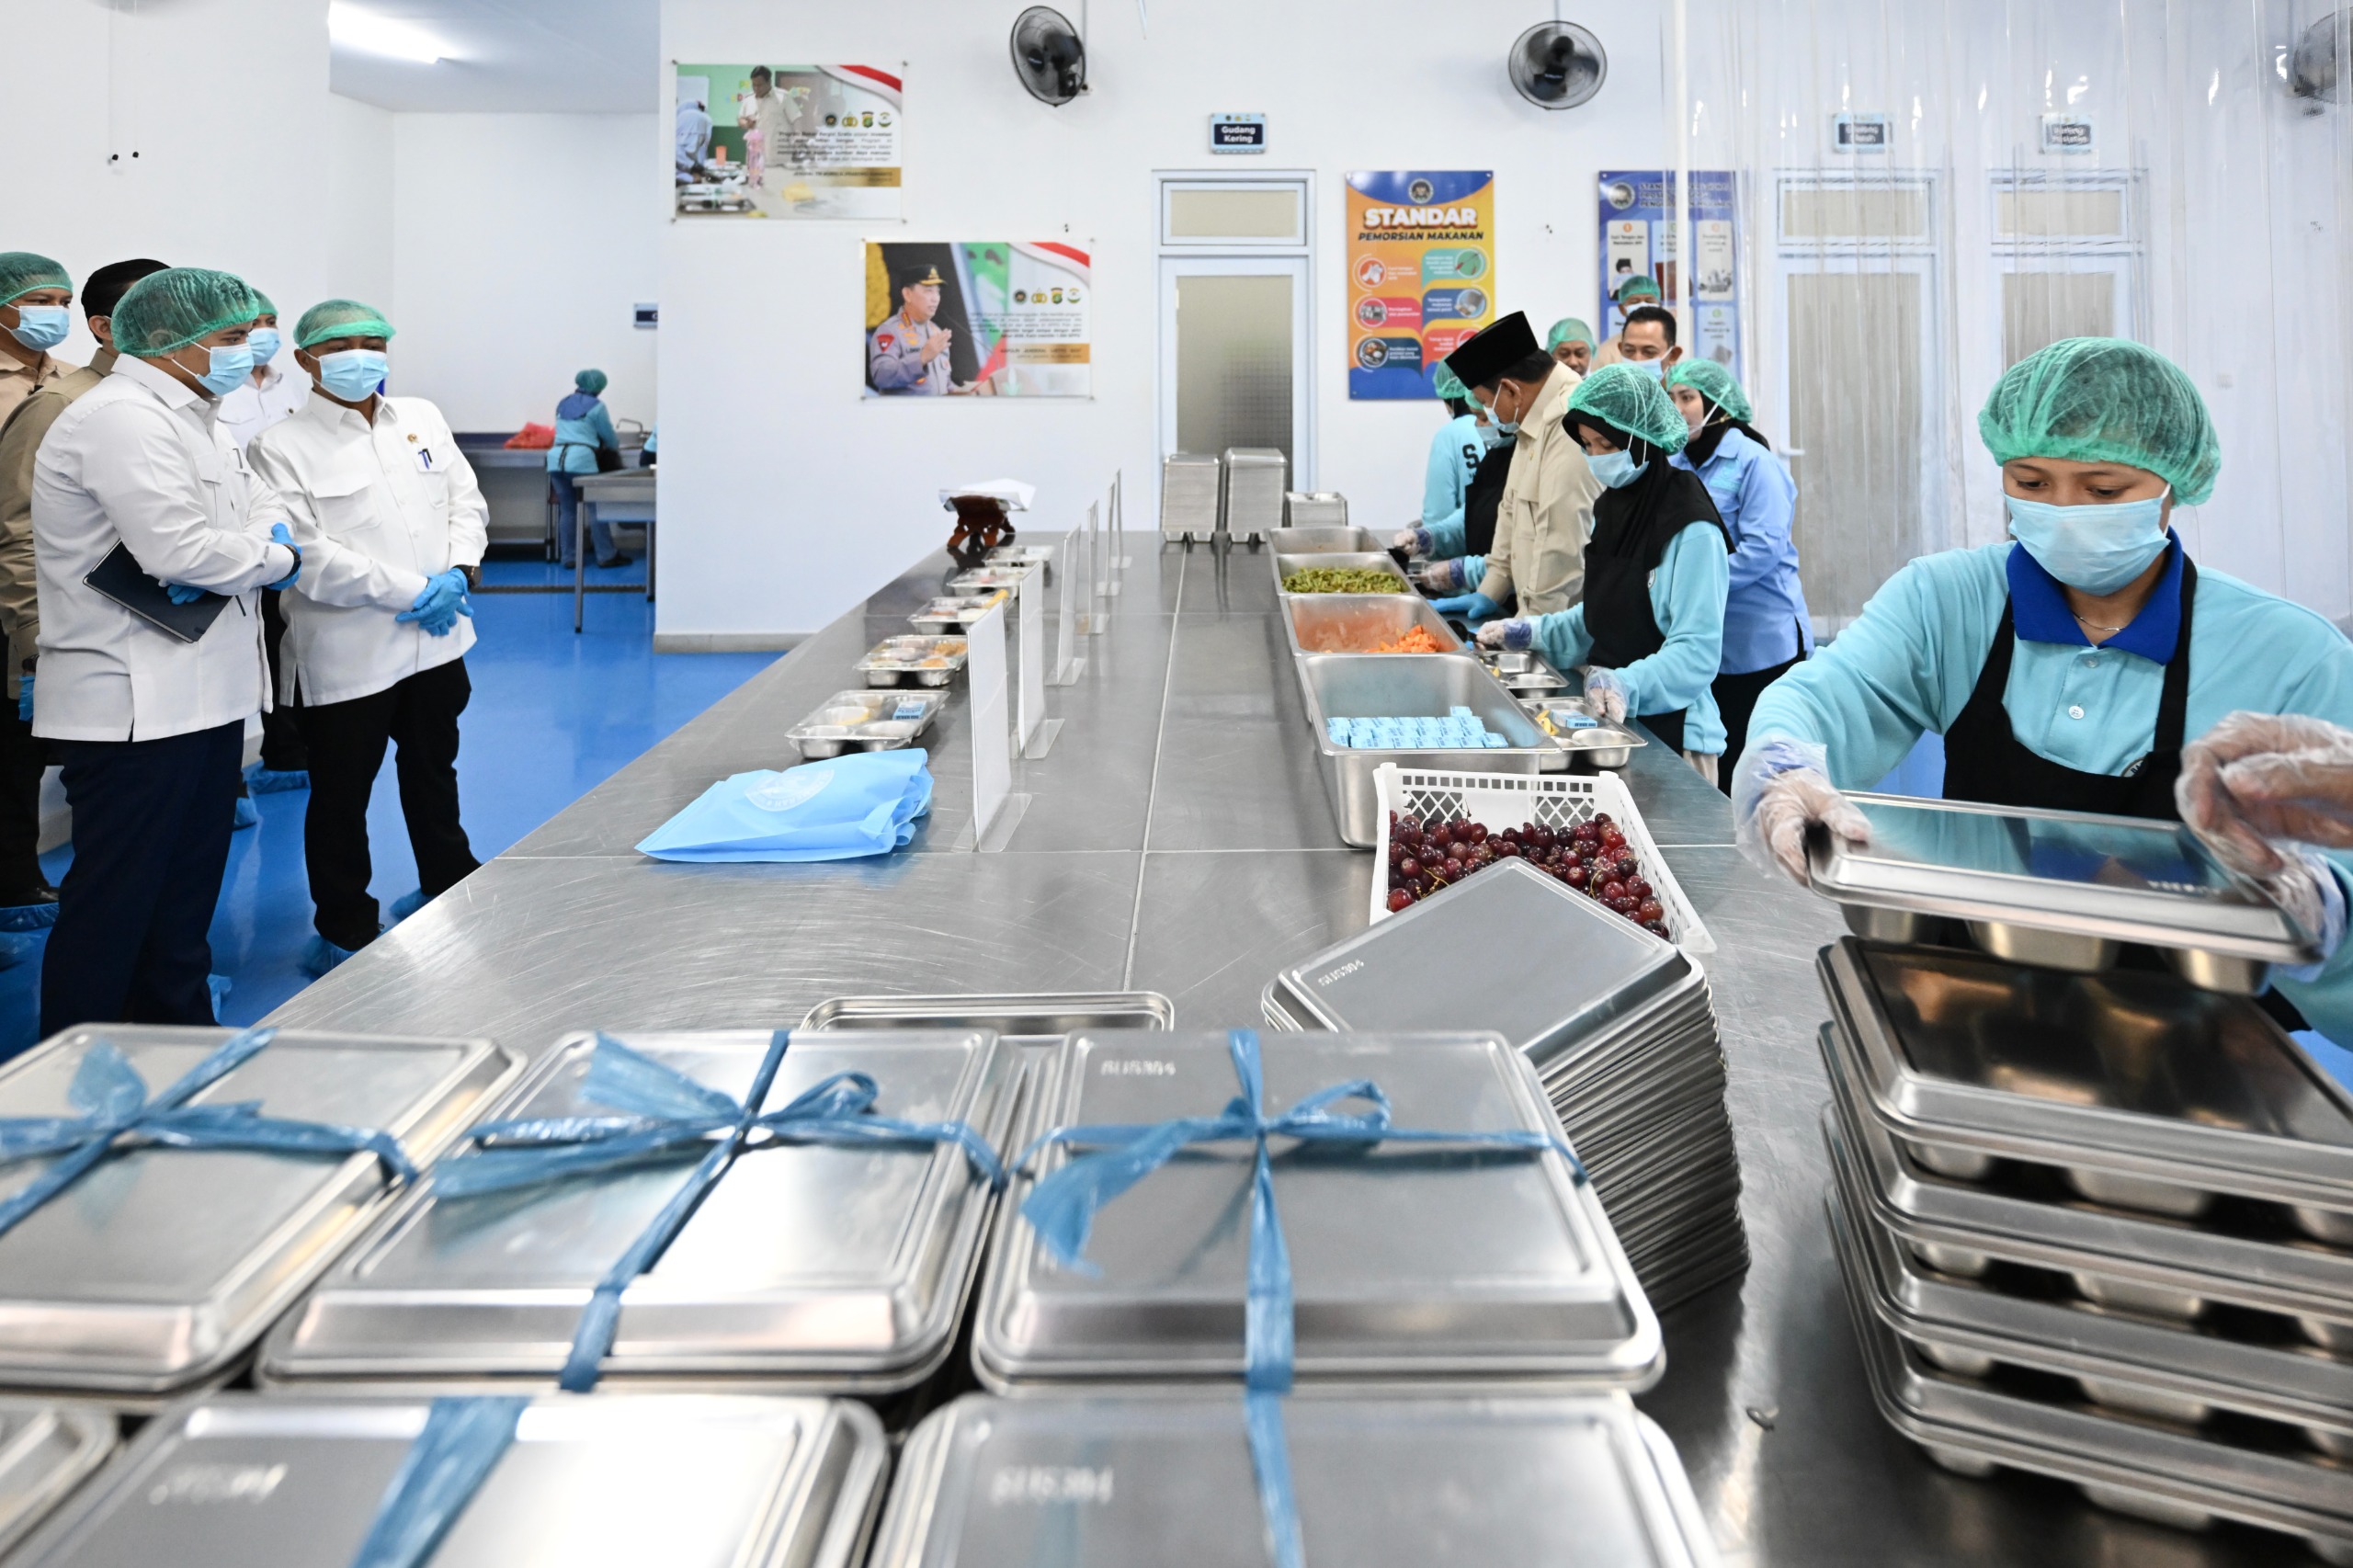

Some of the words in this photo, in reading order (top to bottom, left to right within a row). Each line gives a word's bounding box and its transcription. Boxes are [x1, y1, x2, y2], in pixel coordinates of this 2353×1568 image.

[1221, 125, 1256, 135] Gudang
[1223, 134, 1254, 143] Kering
[1363, 207, 1478, 229] STANDAR
[1358, 232, 1424, 241] PEMORSIAN
[1427, 231, 1484, 240] MAKANAN
